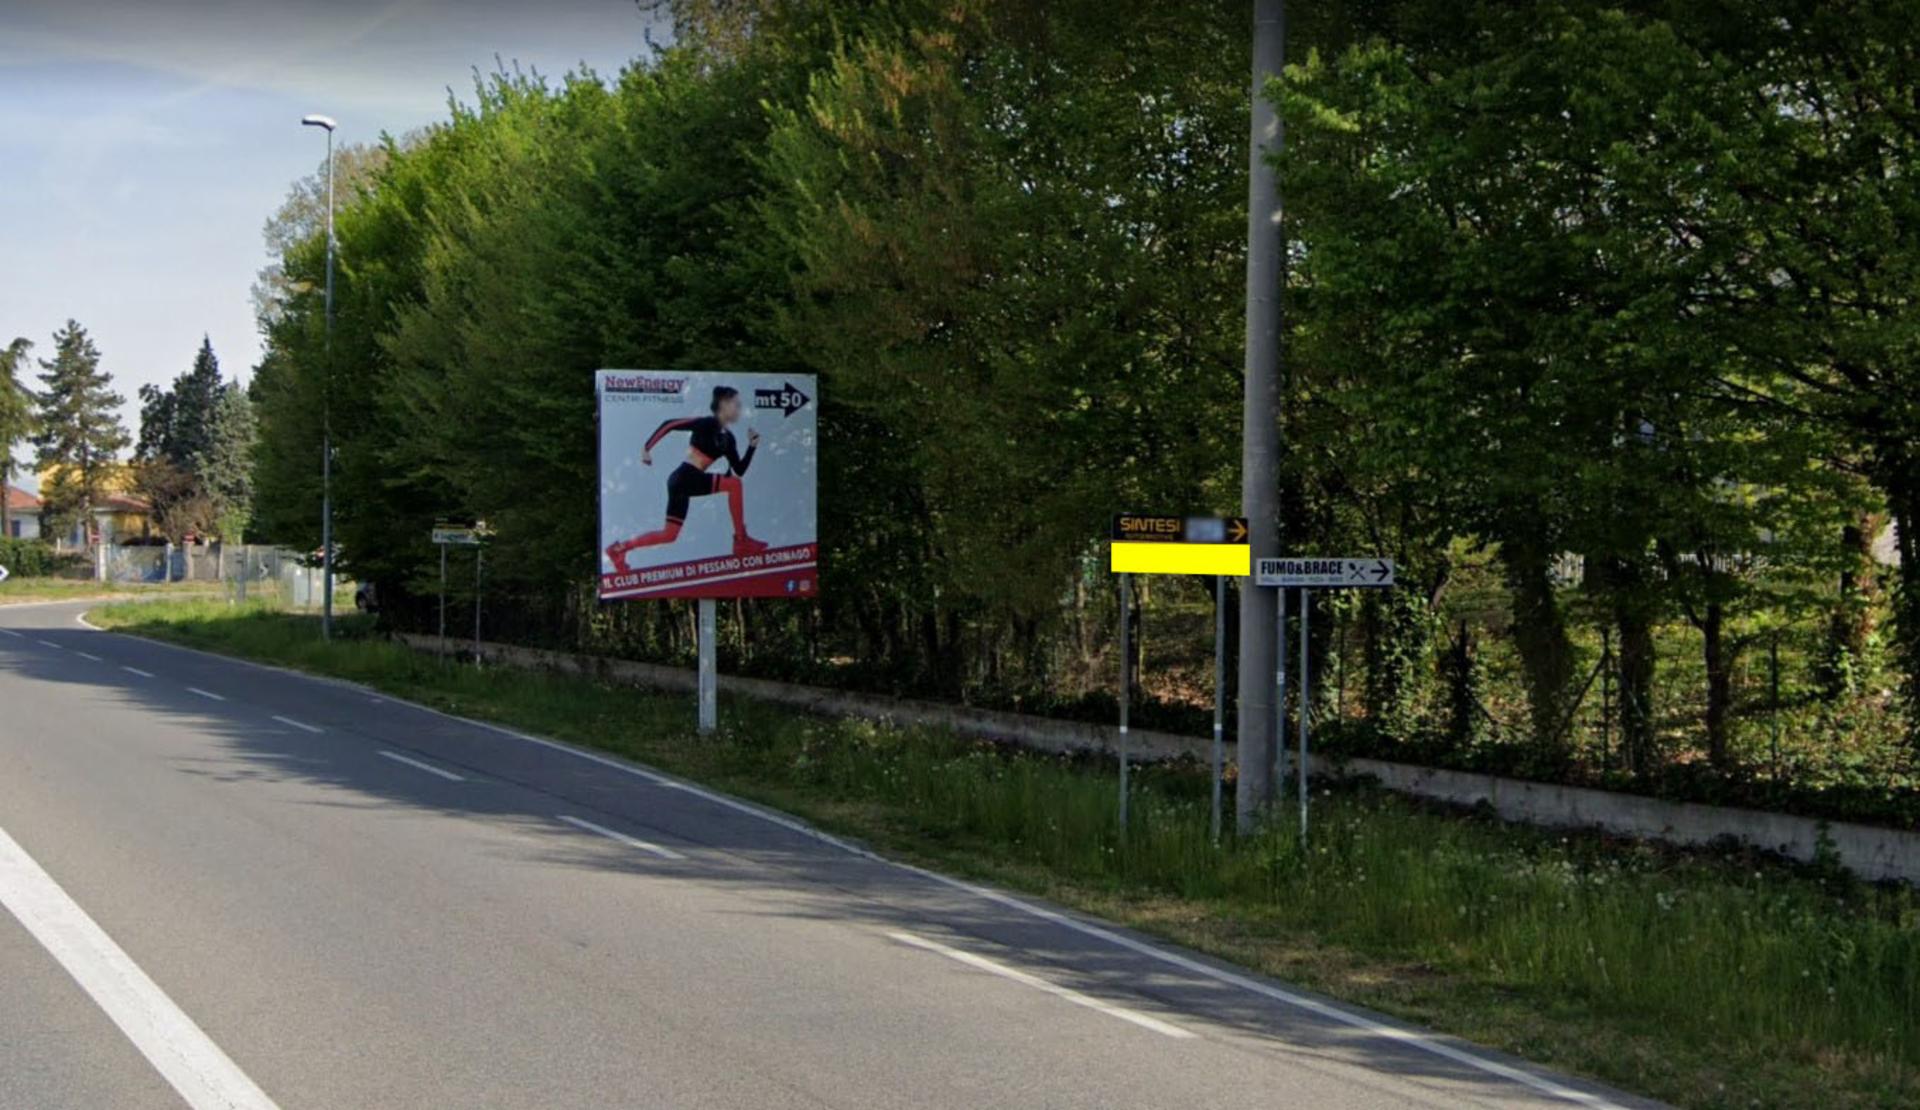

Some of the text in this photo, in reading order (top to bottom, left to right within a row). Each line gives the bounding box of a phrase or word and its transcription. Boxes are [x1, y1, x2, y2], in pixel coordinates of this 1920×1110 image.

[605, 376, 684, 391] NewEnergy
[756, 392, 800, 407] mt 50
[1120, 517, 1180, 532] SINTESI
[603, 577, 613, 589] IL
[614, 573, 639, 588] CLUB
[641, 567, 685, 584] PREMIUM
[686, 564, 697, 577] DI
[698, 558, 740, 575] PESSANO
[742, 555, 763, 568] CON
[1261, 561, 1344, 575] FUMO&BRACE
